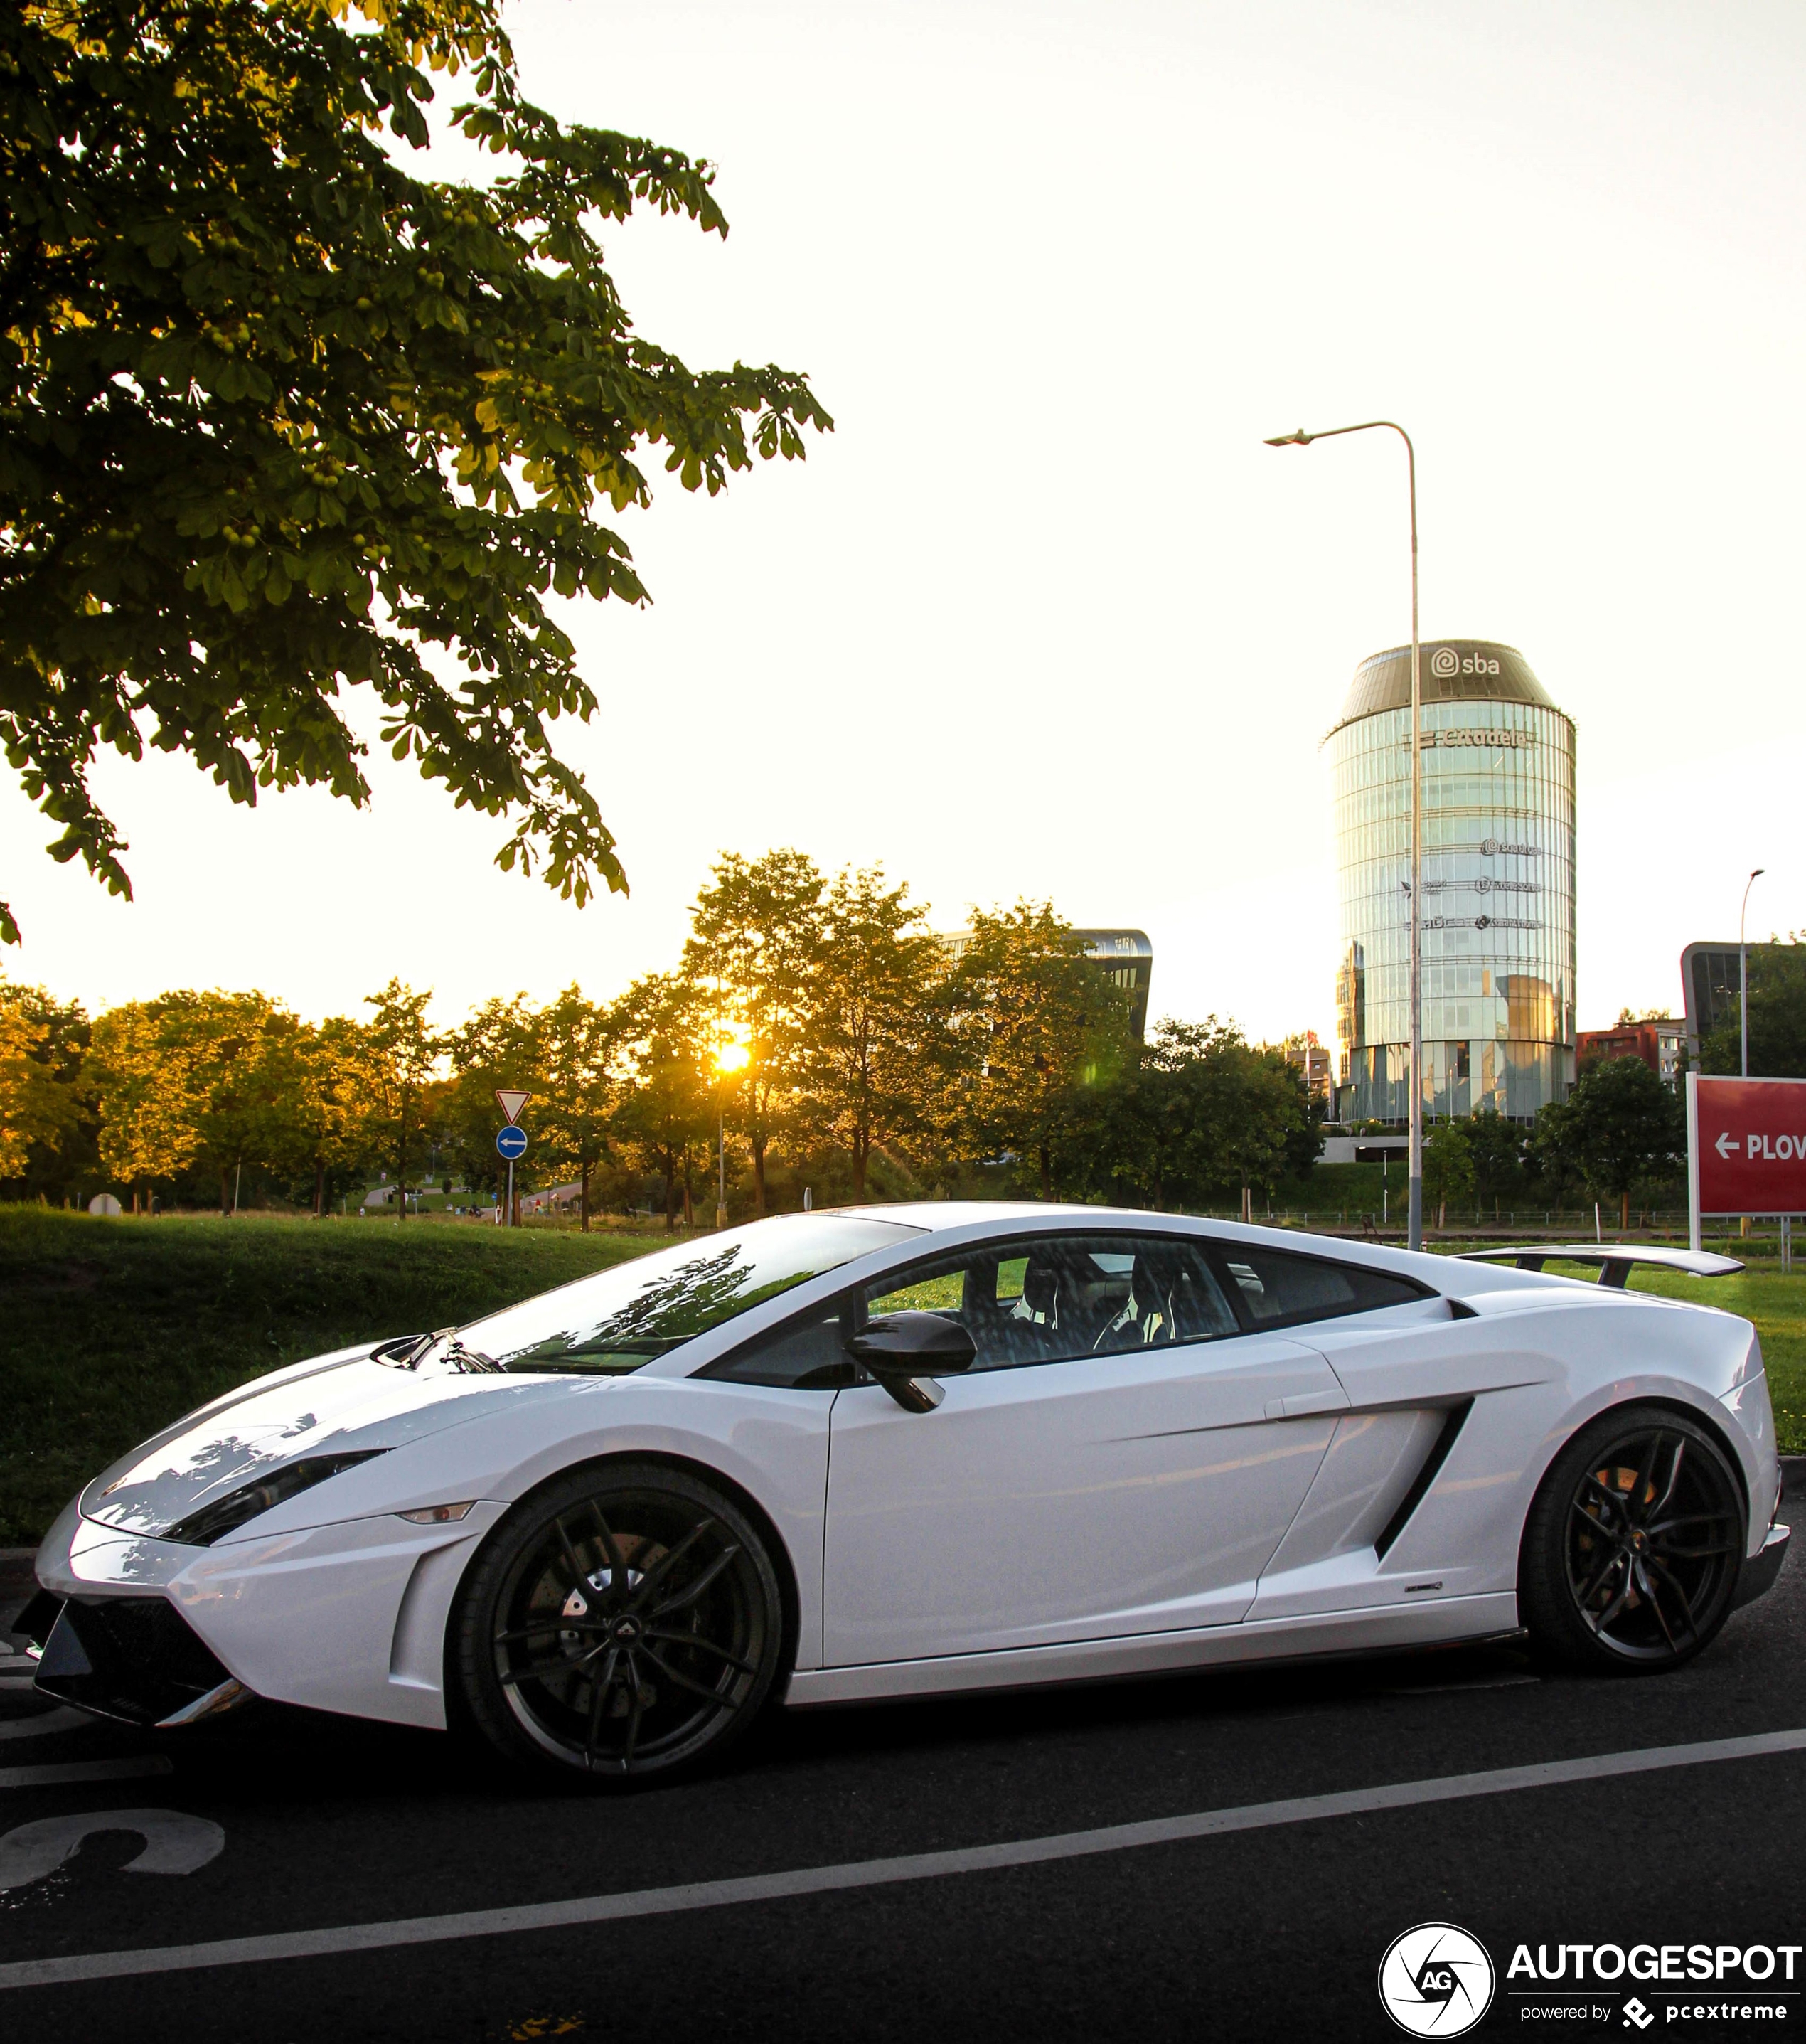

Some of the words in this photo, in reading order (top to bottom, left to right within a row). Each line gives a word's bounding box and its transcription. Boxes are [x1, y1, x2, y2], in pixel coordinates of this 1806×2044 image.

[1462, 652, 1500, 675] sba
[1443, 728, 1527, 747] Citadele
[1748, 1134, 1806, 1160] PLOV
